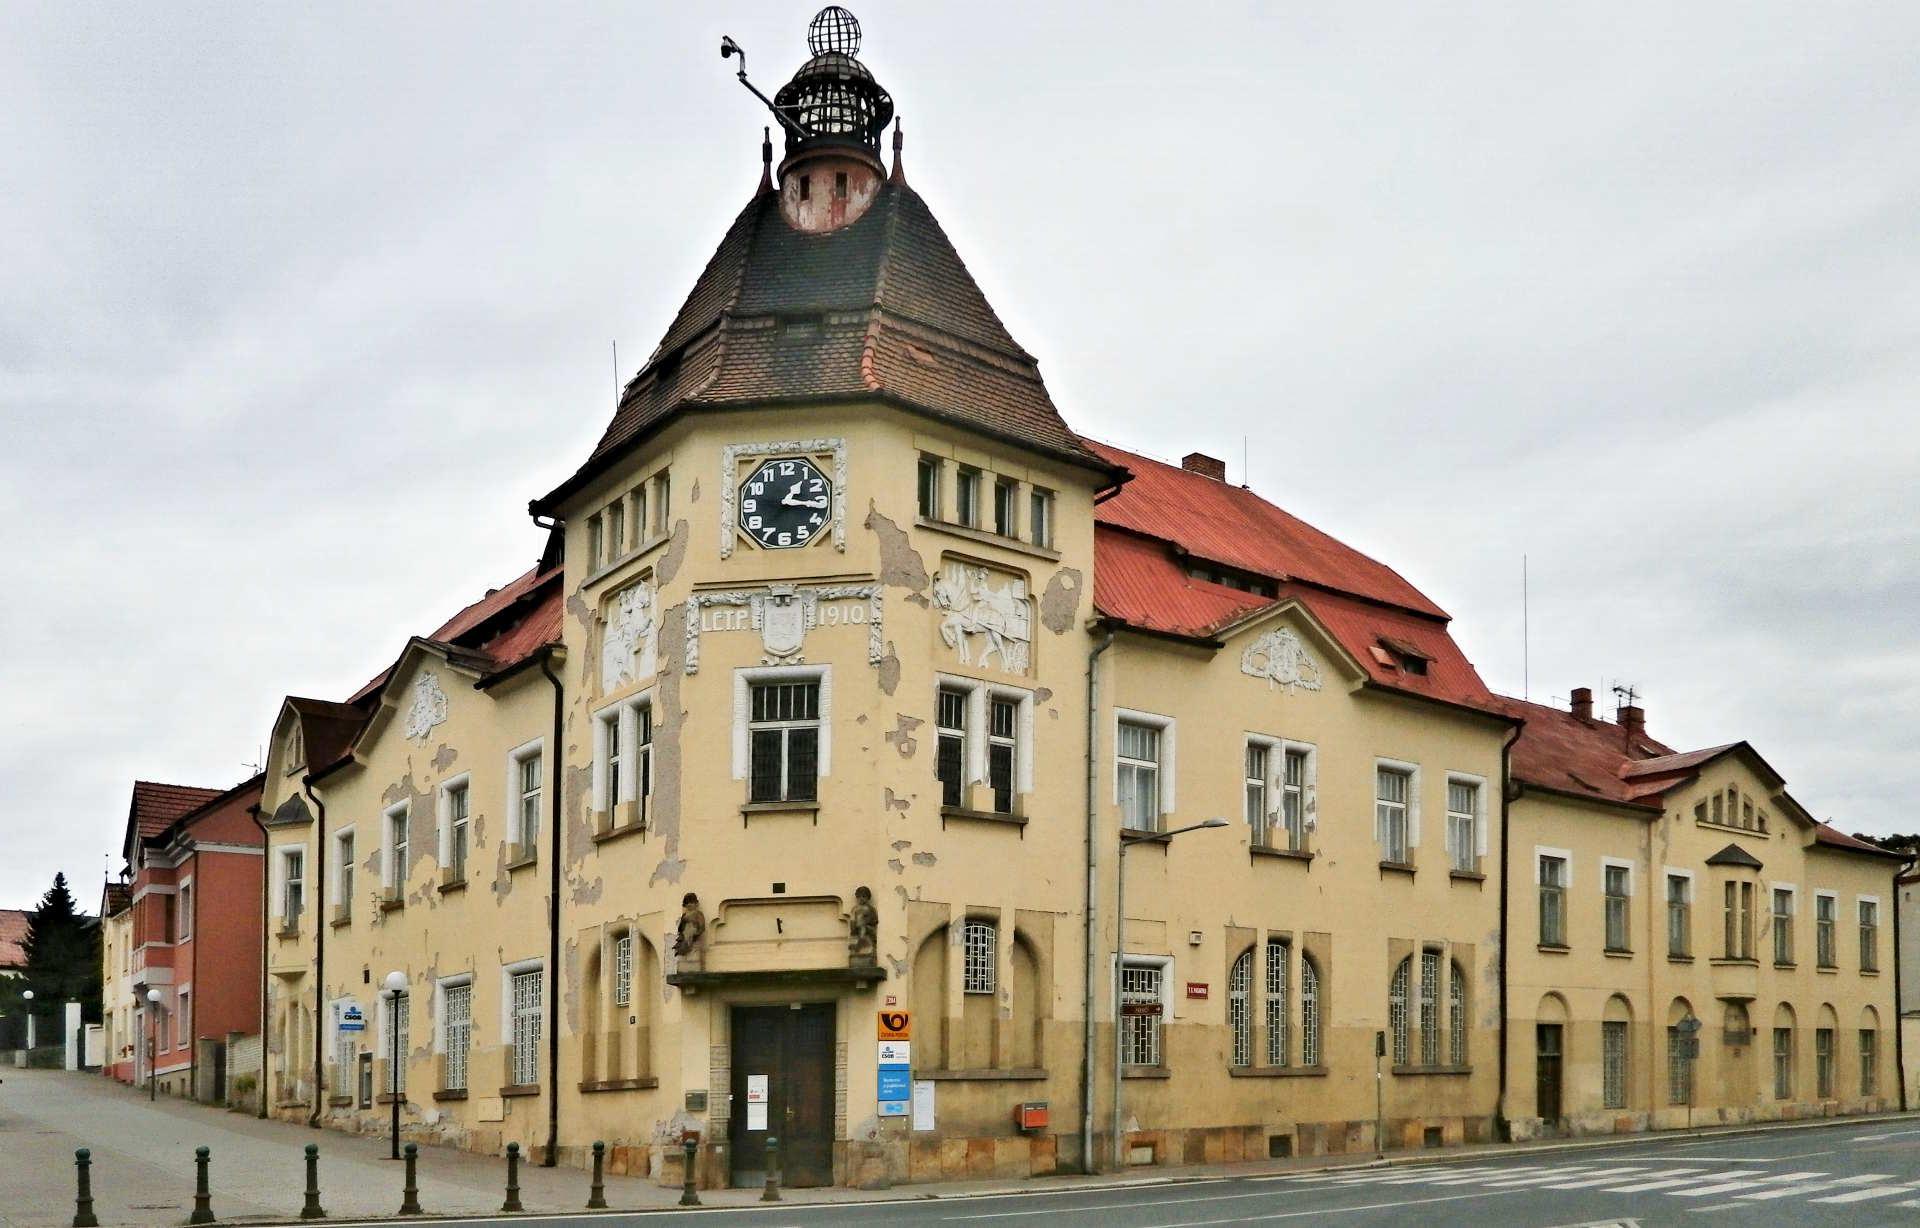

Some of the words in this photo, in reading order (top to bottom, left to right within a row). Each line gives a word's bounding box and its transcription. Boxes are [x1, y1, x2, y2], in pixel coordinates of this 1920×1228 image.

[763, 468, 775, 482] 11
[778, 462, 795, 476] 12
[801, 466, 809, 480] 1
[749, 482, 764, 496] 10
[809, 478, 823, 493] 2
[743, 499, 757, 513] 9
[814, 495, 828, 509] 3
[748, 515, 763, 529] 8
[809, 512, 823, 526] 4
[762, 527, 776, 542] 7
[777, 532, 791, 546] 6
[797, 525, 810, 540] 5
